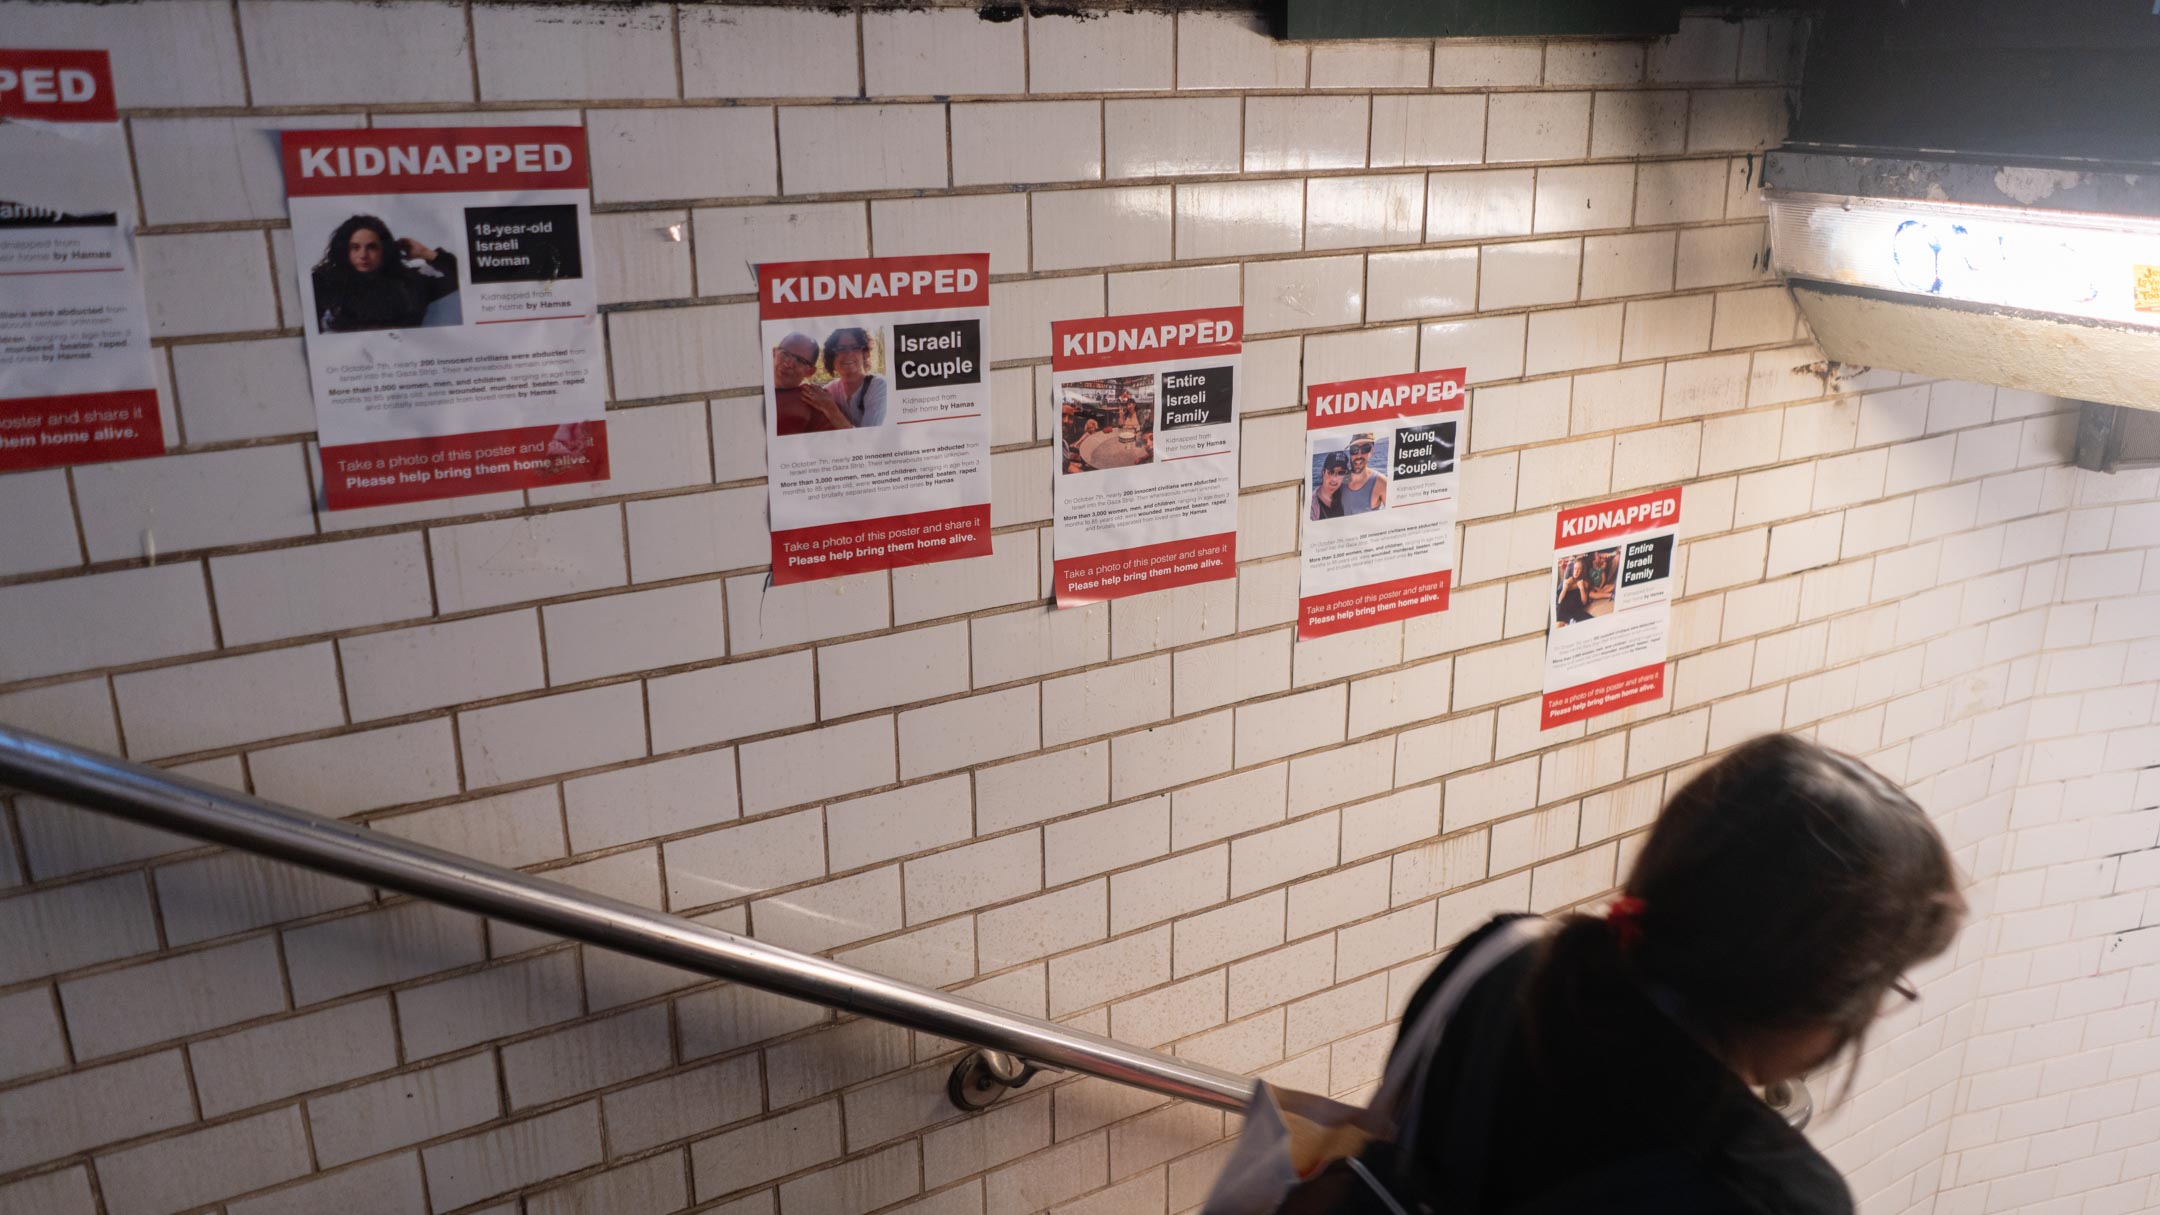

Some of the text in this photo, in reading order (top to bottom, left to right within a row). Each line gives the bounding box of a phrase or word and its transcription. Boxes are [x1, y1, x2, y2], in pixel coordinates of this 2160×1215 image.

[298, 142, 574, 179] KIDNAPPED
[474, 221, 553, 237] 18-year-old
[475, 239, 519, 251] Israeli
[477, 254, 530, 267] Woman
[771, 268, 978, 303] KIDNAPPED
[526, 301, 538, 311] by
[539, 299, 572, 308] Hamas
[900, 330, 961, 352] Israeli
[1063, 320, 1234, 357] KIDNAPPED
[901, 356, 972, 382] Couple
[1167, 373, 1205, 388] Entire
[902, 394, 939, 405] Kidnapped
[902, 400, 974, 414] their home by Hamas
[1167, 390, 1205, 406] Israeli
[1315, 380, 1458, 417] KIDNAPPED
[48, 409, 80, 426] and
[84, 407, 129, 422] share
[133, 406, 143, 420] it
[1166, 408, 1208, 426] Family
[41, 430, 89, 446] home
[94, 426, 139, 442] alive.
[1196, 441, 1204, 449] by
[1206, 439, 1226, 447] Hamas
[1399, 428, 1435, 445] Young
[337, 457, 372, 473] Take
[374, 458, 384, 469] a
[387, 452, 428, 470] photo
[430, 450, 443, 463] of
[446, 448, 471, 462] this
[473, 444, 516, 462] poster
[518, 441, 544, 455] and
[585, 436, 593, 448] it
[864, 451, 892, 460] innocent
[894, 448, 919, 456] civilians
[937, 443, 964, 452] abducted
[1398, 444, 1432, 459] Israeli
[345, 453, 589, 489] Please help bring them home alive.
[1398, 459, 1437, 477] Couple
[780, 480, 797, 488] More
[798, 478, 813, 486] than
[815, 476, 832, 484] 3,000
[1561, 497, 1676, 538] KIDNAPPED
[783, 516, 979, 553] Take a photo of this poster and share it
[788, 531, 976, 567] Please help bring them home alive.
[1629, 542, 1653, 556] Entire
[1064, 543, 1227, 579] Take a photo of this poster and share it
[1626, 554, 1652, 569] Israeli
[1068, 557, 1223, 591] Please help bring them home alive.
[1625, 566, 1654, 584] Family
[1306, 579, 1444, 615] Take a photo of this poster and share it
[1308, 591, 1439, 626] Please help bring them home alive.
